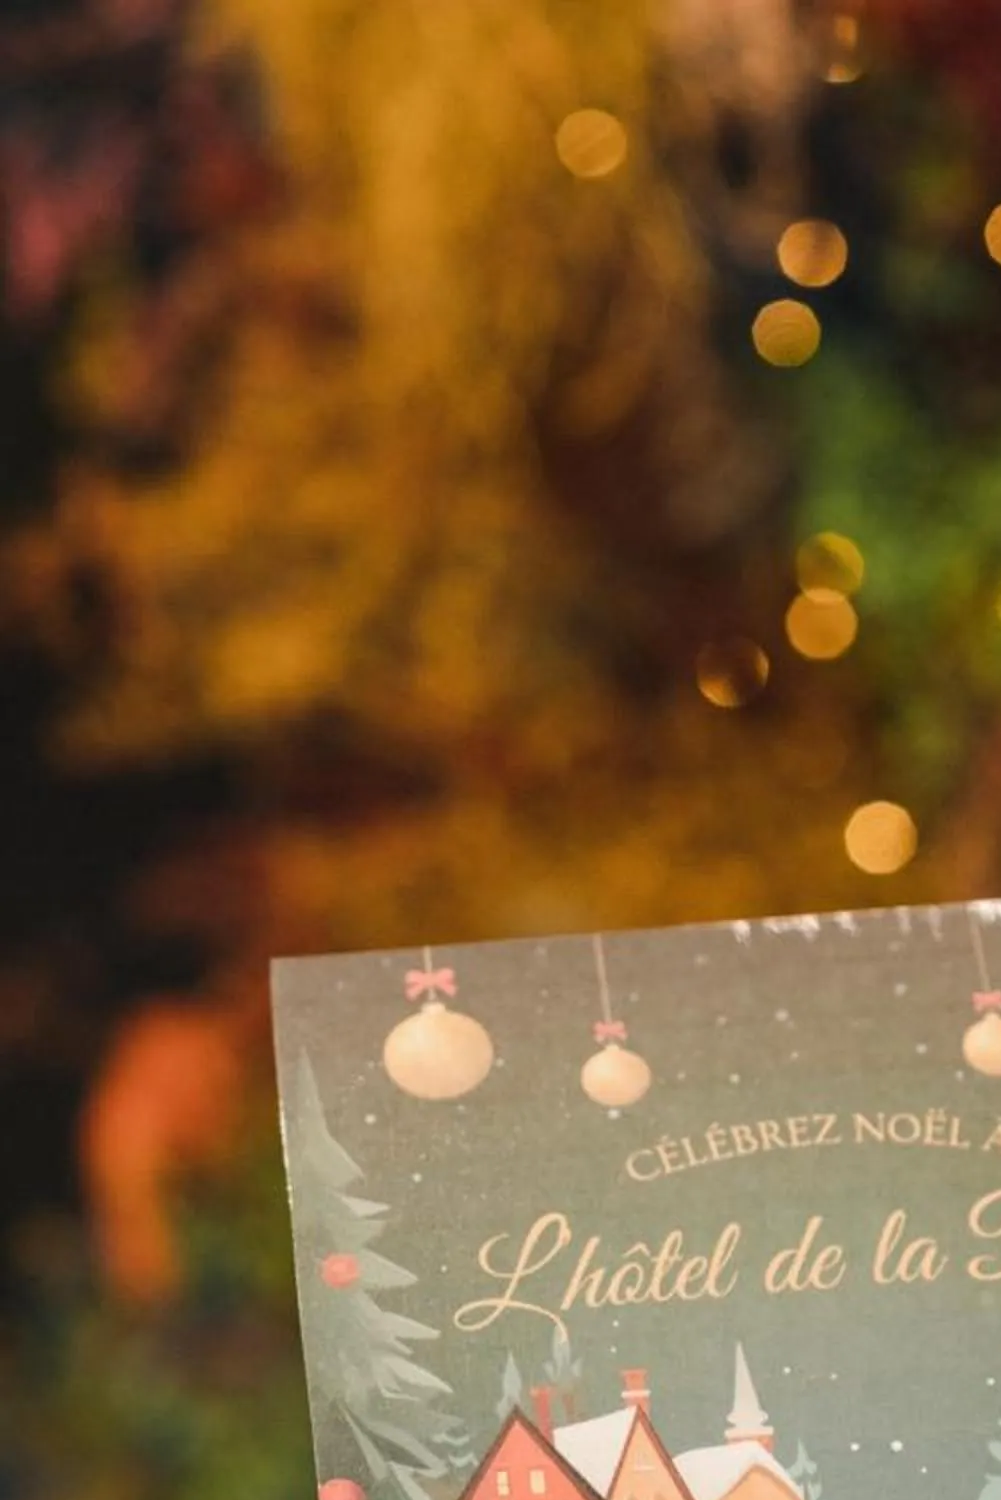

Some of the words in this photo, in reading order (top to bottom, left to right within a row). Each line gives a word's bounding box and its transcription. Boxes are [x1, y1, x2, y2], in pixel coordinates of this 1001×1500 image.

[624, 1111, 841, 1182] CÉLÉBREZ
[852, 1107, 970, 1149] NOËL
[764, 1215, 847, 1294] de
[872, 1208, 949, 1284] la
